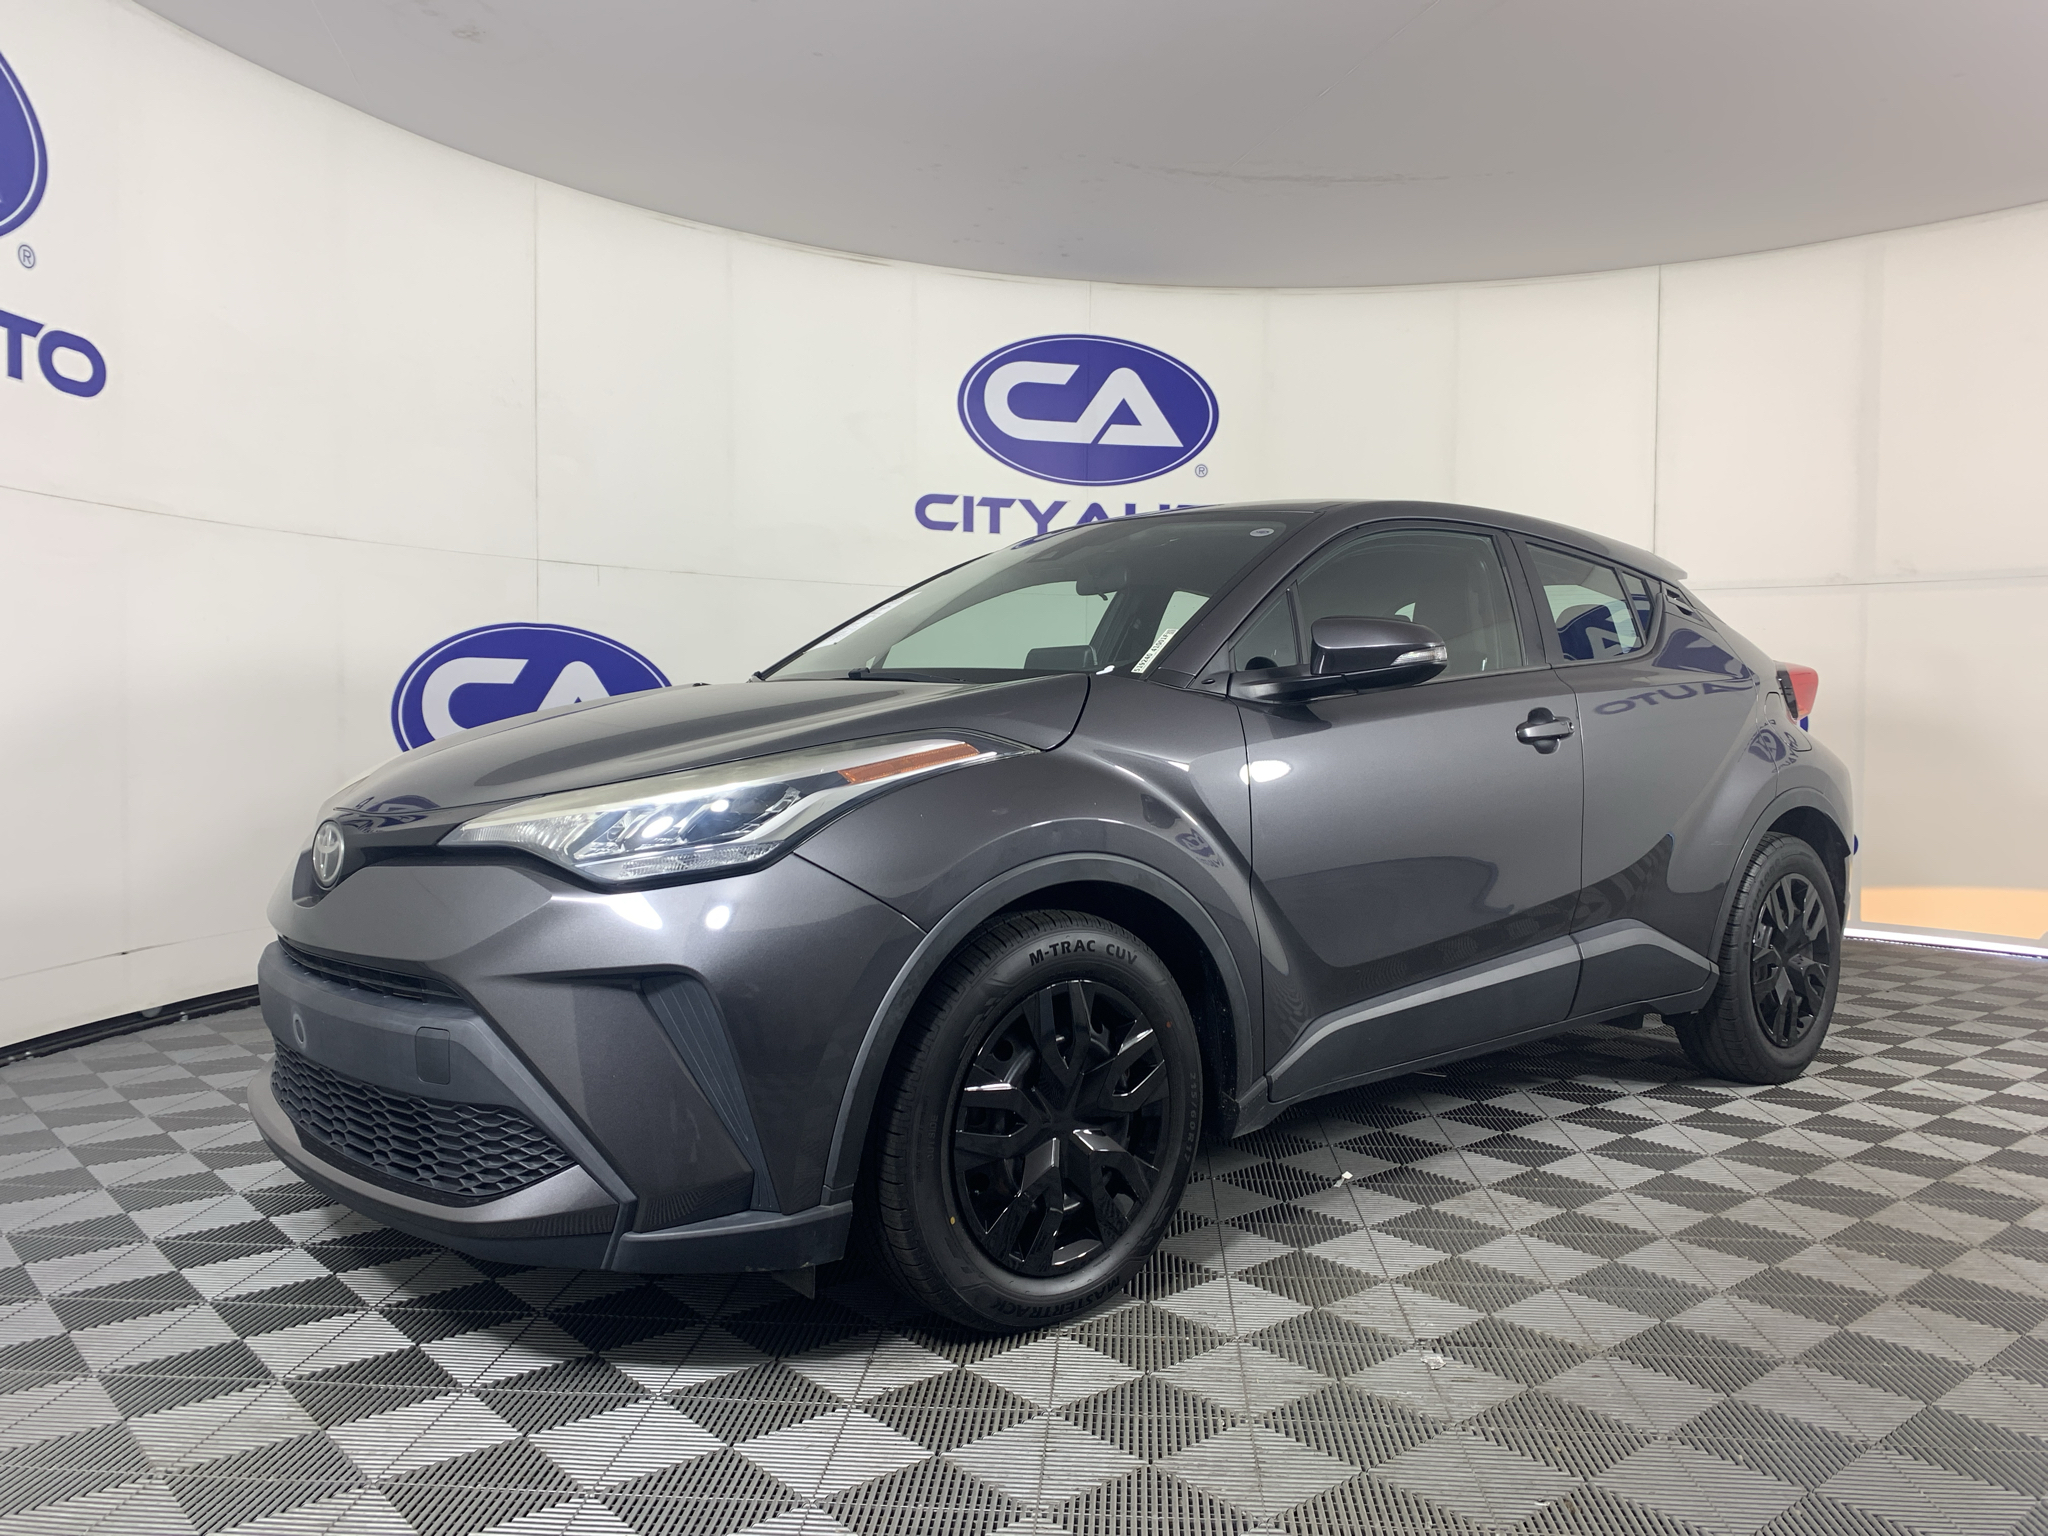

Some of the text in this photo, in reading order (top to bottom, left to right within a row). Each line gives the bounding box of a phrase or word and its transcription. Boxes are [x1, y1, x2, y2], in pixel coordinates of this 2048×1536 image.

[0, 310, 106, 397] TO
[984, 361, 1184, 447] CA
[914, 493, 1068, 535] CITY
[1029, 940, 1138, 966] M-TRAC CUV
[926, 1114, 939, 1161] OUTSIDE
[1184, 1072, 1198, 1163] 215/60R17
[990, 1276, 1119, 1319] MASTERTRACK
